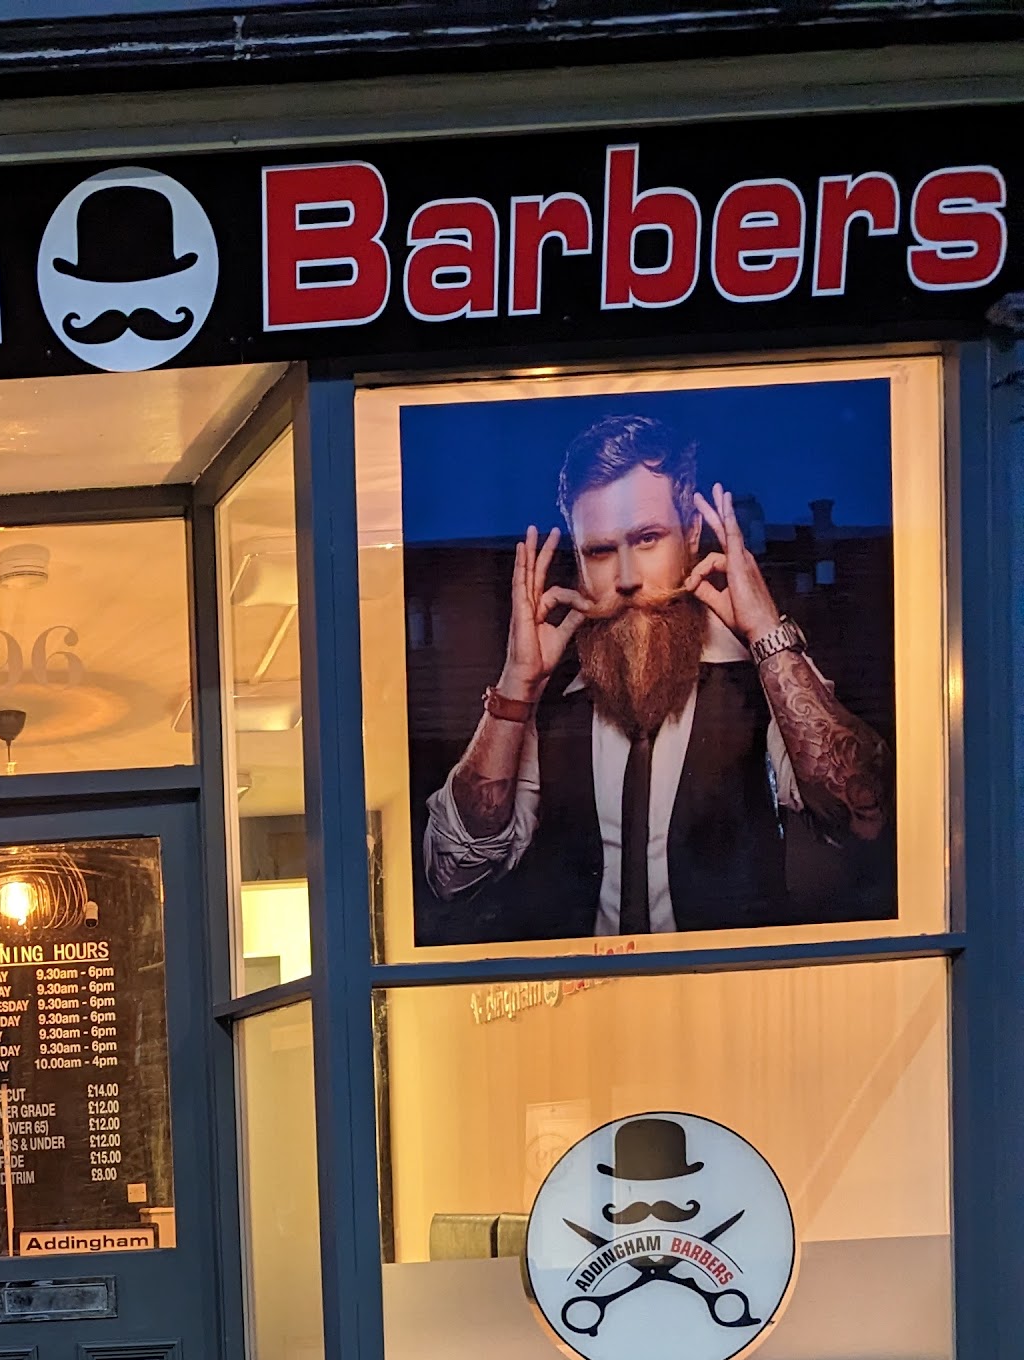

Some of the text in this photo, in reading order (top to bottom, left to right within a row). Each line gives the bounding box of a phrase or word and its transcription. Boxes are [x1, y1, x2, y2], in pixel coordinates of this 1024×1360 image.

[261, 142, 1007, 332] Barbers
[53, 942, 109, 960] HOURS
[36, 968, 78, 981] 9.30am
[88, 966, 114, 978] 6pm
[37, 983, 78, 996] 9.30am
[89, 981, 114, 993] 6pm
[37, 997, 79, 1010] 9.30am
[89, 996, 115, 1008] 6pm
[38, 1012, 80, 1025] 9.30am
[90, 1011, 116, 1023] 6pm
[39, 1027, 80, 1040] 9.30am
[91, 1025, 117, 1038] 6pm
[40, 1042, 81, 1055] 9.30am
[91, 1040, 117, 1053] 6pm
[34, 1058, 82, 1070] 10.00am
[92, 1056, 118, 1068] 4pm
[7, 1088, 26, 1101] CUT
[88, 1083, 119, 1098] £14.00
[20, 1103, 56, 1118] GRADE
[88, 1100, 120, 1114] £12.00
[3, 1121, 33, 1135] OVER
[34, 1120, 49, 1135] 65)
[89, 1117, 120, 1131] £12.00
[20, 1138, 28, 1151] &
[30, 1136, 66, 1151] UNDER
[89, 1134, 121, 1148] £12.00
[90, 1151, 121, 1165] £15.00
[11, 1171, 35, 1185] TRIM
[91, 1167, 117, 1182] £8.00
[26, 1235, 149, 1251] Addingham
[574, 1236, 734, 1292] ADDINGHAM BARBERS
